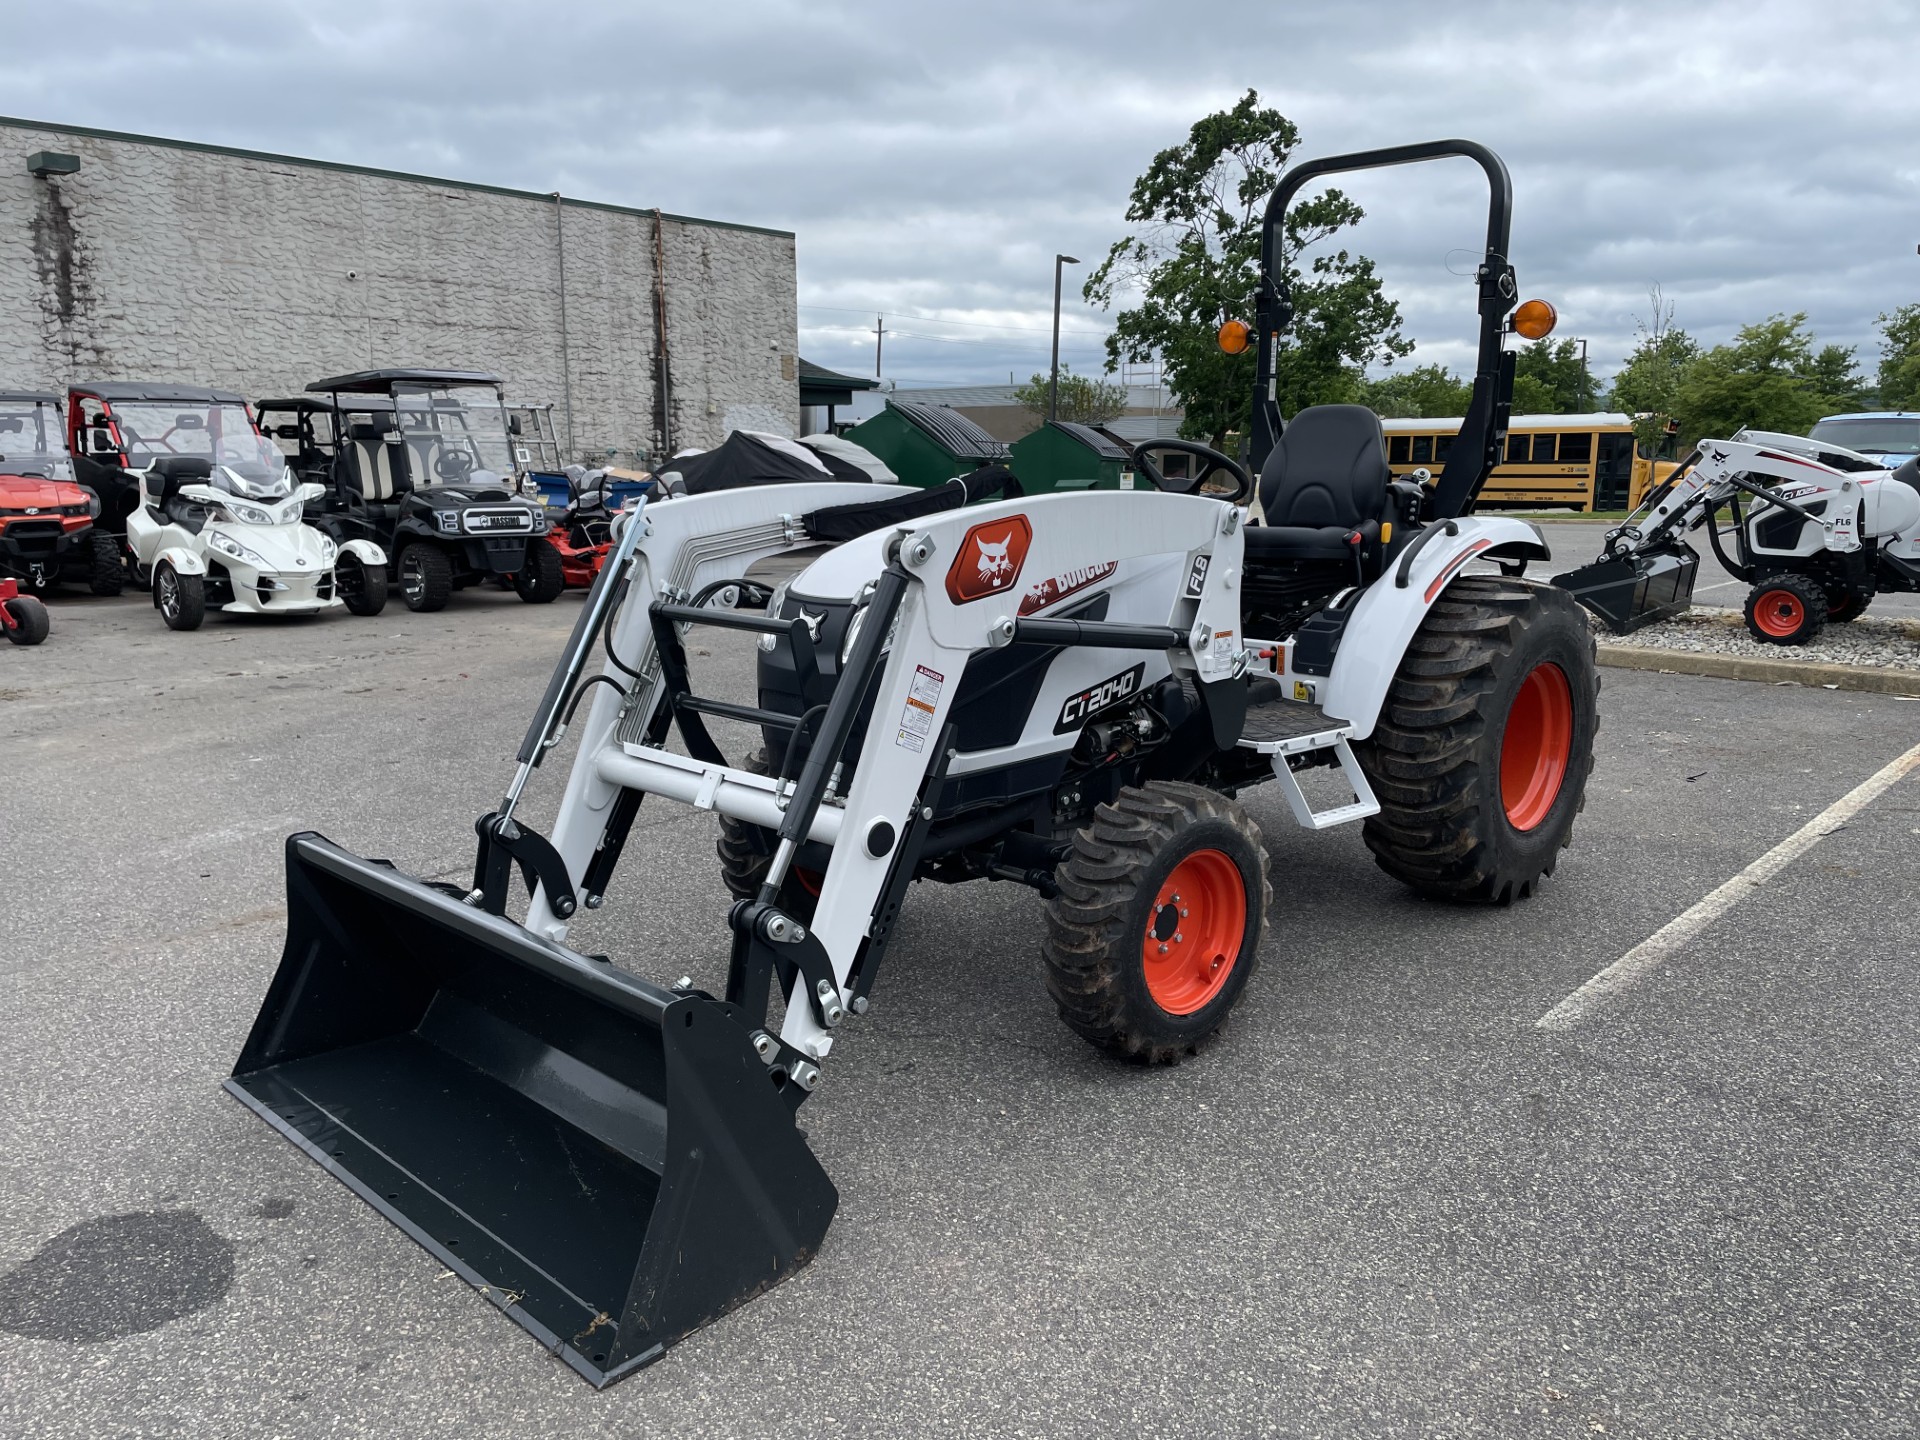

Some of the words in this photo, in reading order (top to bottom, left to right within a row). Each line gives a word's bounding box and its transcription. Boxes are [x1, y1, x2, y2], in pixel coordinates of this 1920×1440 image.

[490, 516, 520, 526] MASSIMO
[1835, 518, 1851, 526] FL6
[1190, 555, 1208, 593] FL8
[1062, 670, 1135, 724] CT2040
